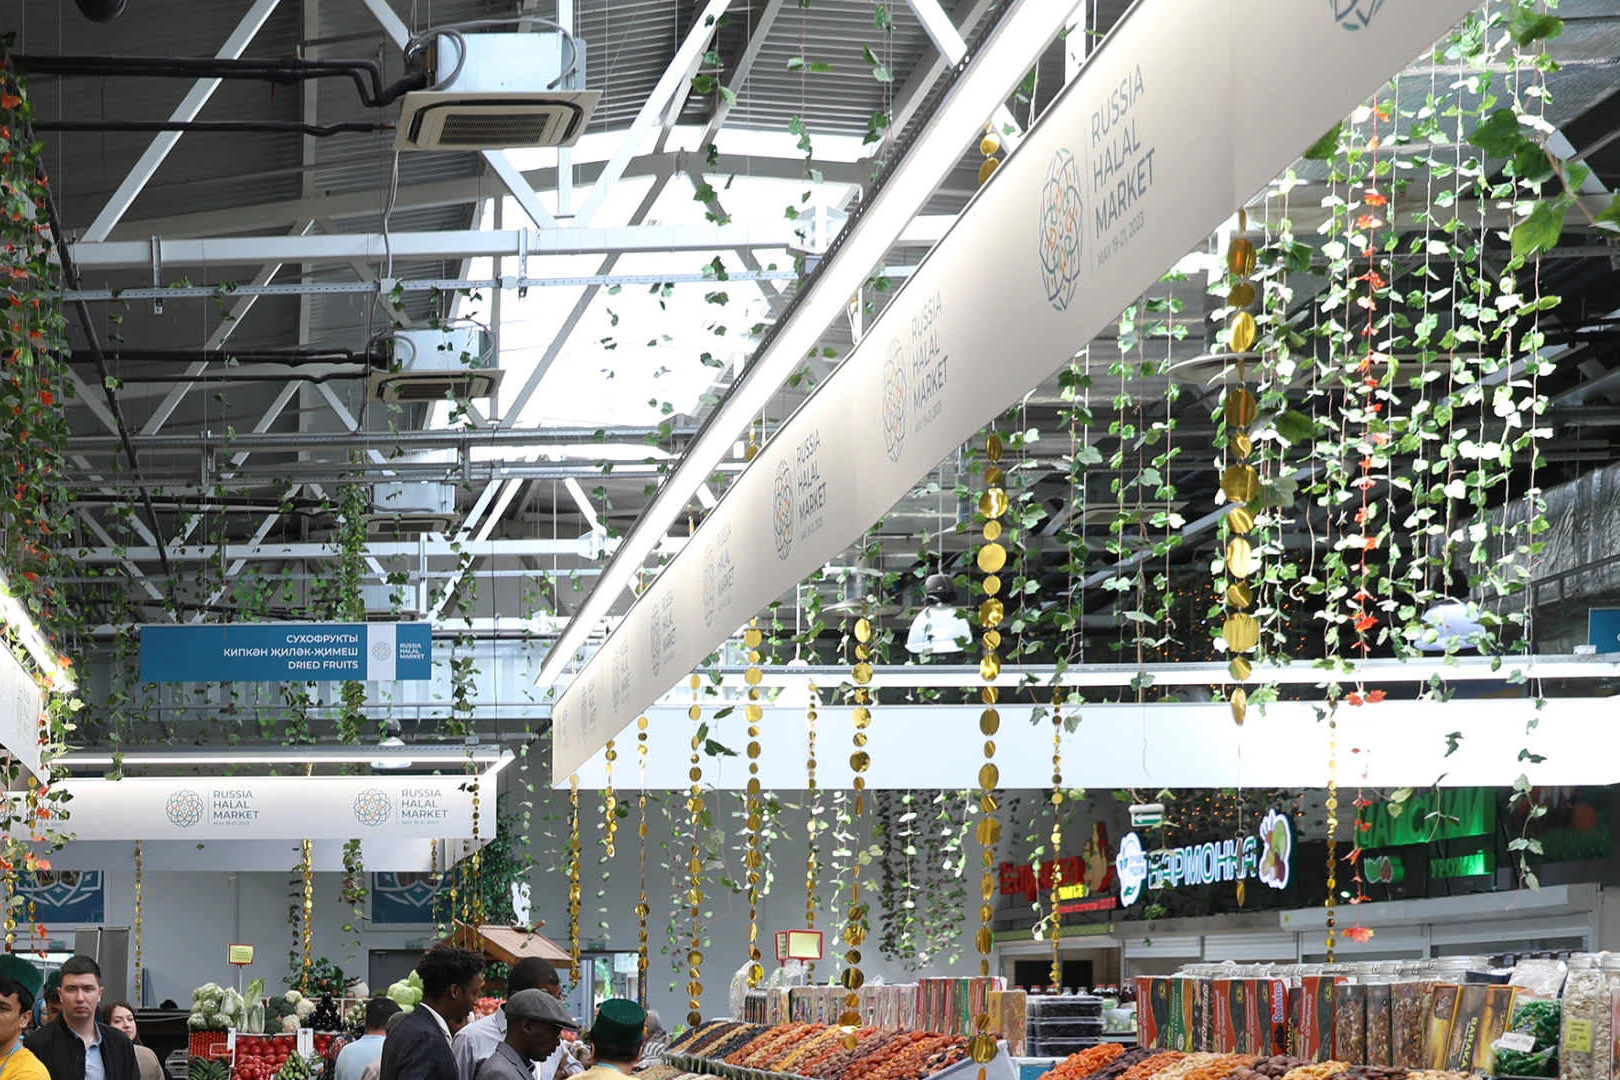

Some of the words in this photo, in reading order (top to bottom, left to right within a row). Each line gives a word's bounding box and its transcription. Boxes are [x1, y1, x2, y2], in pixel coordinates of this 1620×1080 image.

[1091, 63, 1145, 148] RUSSIA
[1093, 118, 1141, 194] HALAL
[1095, 147, 1155, 239] MARKET
[1098, 242, 1112, 268] MAY
[1128, 210, 1145, 241] 2023
[912, 289, 942, 344] RUSSIA
[912, 329, 940, 380] HALAL
[914, 354, 948, 414] MARKET
[796, 428, 821, 468] RUSSIA
[798, 459, 820, 496] HALAL
[798, 481, 827, 525] MARKET
[224, 648, 268, 657] КИПКӘН
[270, 648, 358, 657] ҖИЛӘК-ҖИМЕШ
[286, 634, 358, 644] СУХОФРУКТЫ
[288, 660, 320, 670] DRIED
[324, 660, 358, 670] FRUITS
[214, 790, 253, 798] RUSSIA
[214, 800, 249, 809] HALAL
[402, 789, 441, 798] RUSSIA
[402, 799, 438, 808] HALAL
[214, 810, 259, 819] MARKET
[402, 810, 448, 818] MARKET
[1272, 981, 1284, 1023] Raisins
[1460, 1016, 1478, 1068] BARAKA
